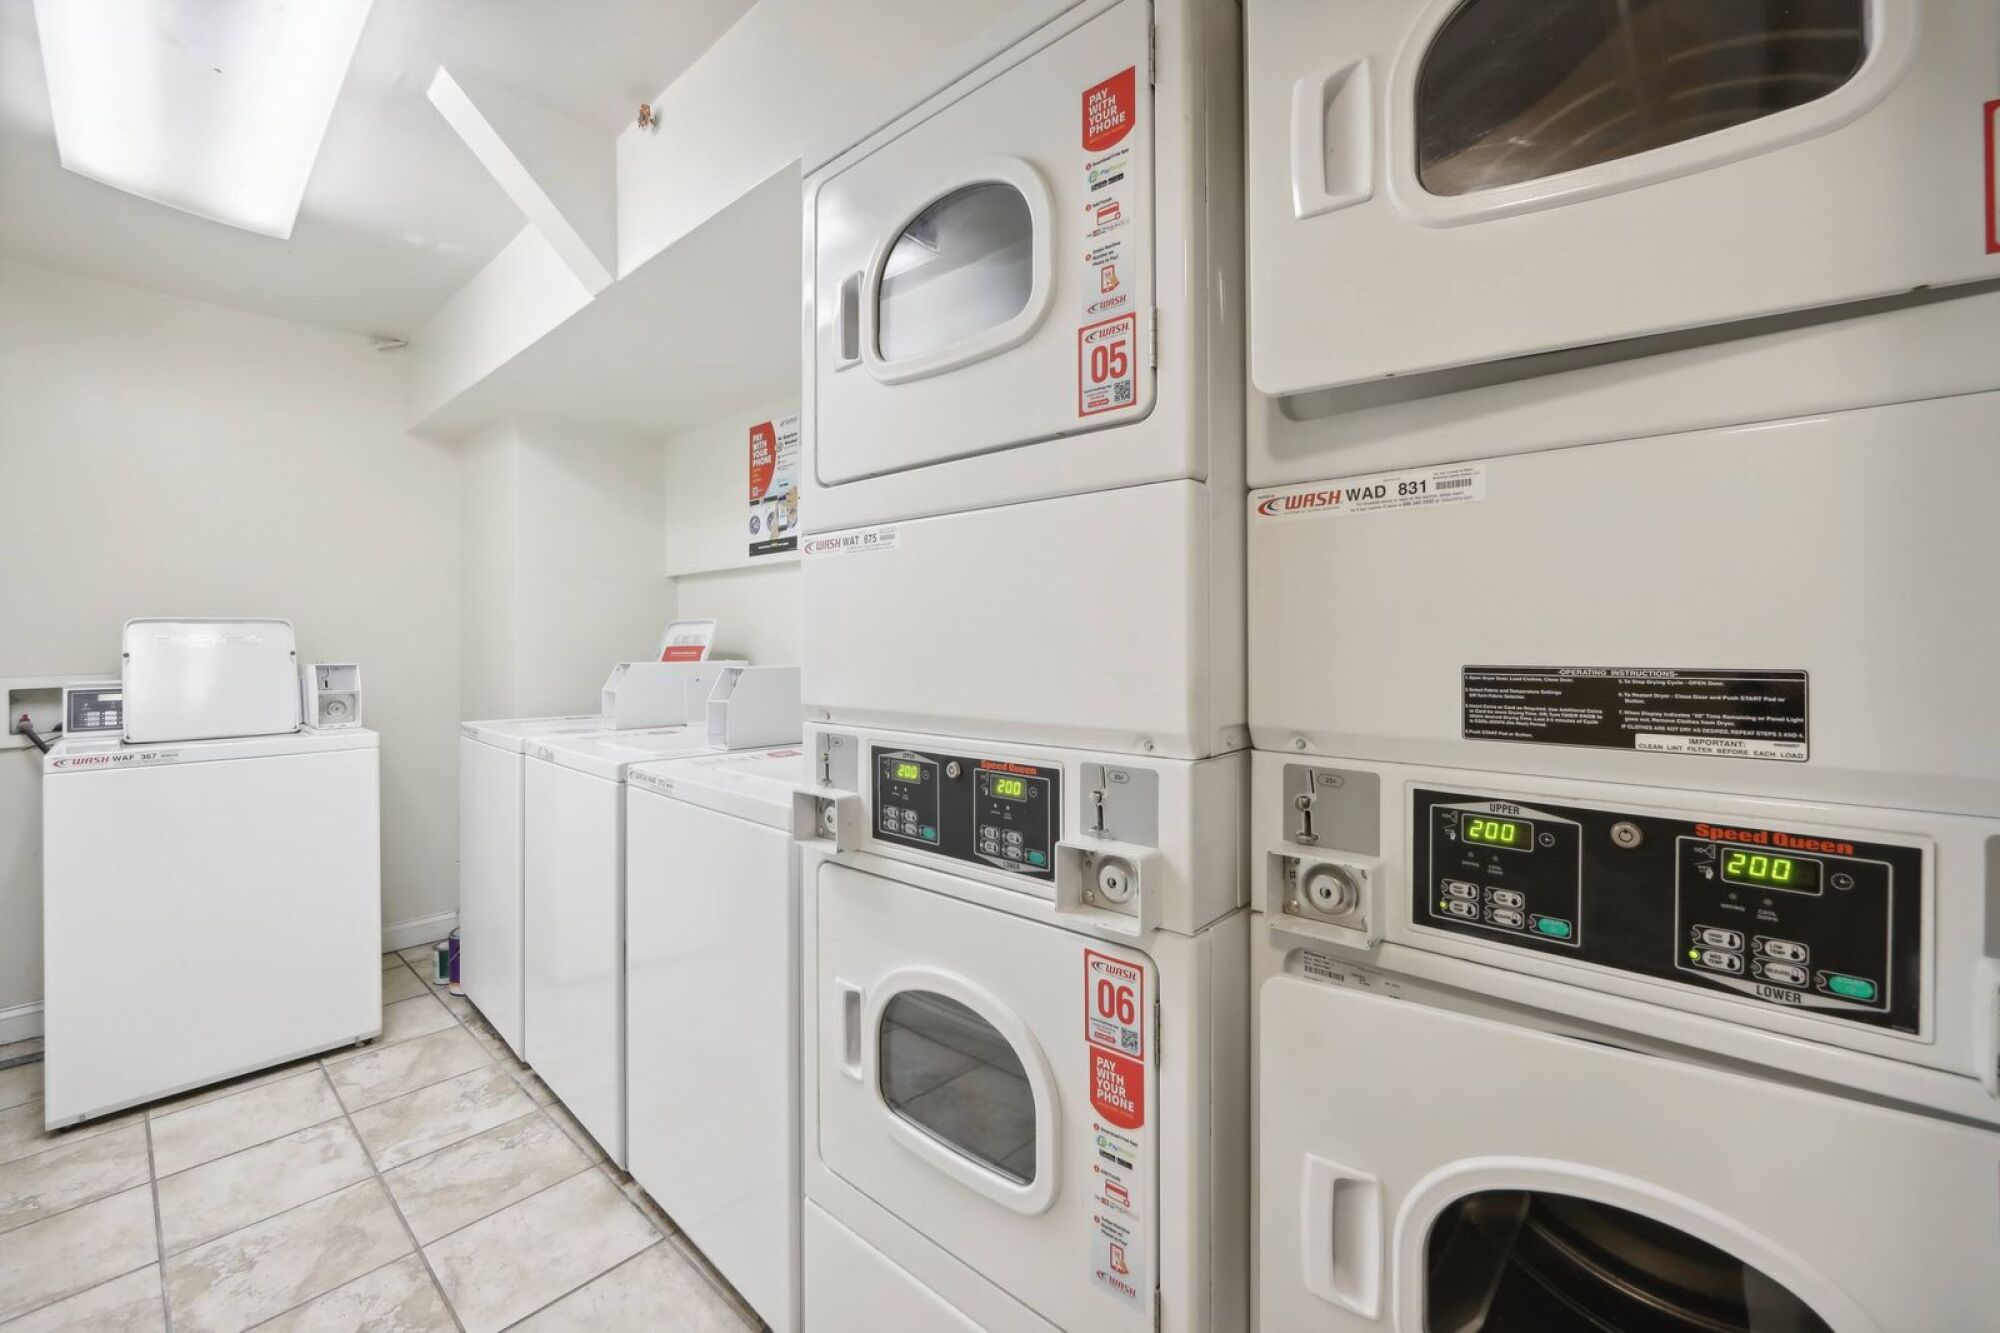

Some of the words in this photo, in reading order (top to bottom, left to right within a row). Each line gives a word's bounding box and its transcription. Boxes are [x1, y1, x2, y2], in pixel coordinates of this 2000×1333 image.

[1089, 88, 1108, 106] PAY
[1089, 94, 1116, 116] WITH
[1089, 105, 1117, 126] YOUR
[1089, 111, 1126, 137] PHONE
[1100, 294, 1126, 308] WASH
[1099, 322, 1129, 339] WASH
[1091, 340, 1128, 384] 05
[1284, 490, 1342, 510] WASH
[1346, 484, 1386, 502] WAD
[1398, 480, 1427, 496] 831
[816, 538, 841, 551] WASH
[842, 536, 860, 546] WAT
[1688, 738, 1746, 748] IMPORTANT:
[1717, 748, 1748, 756] BEFORE
[72, 756, 109, 766] WASH
[112, 754, 134, 762] WAF
[980, 760, 1008, 771] Speed
[1008, 763, 1037, 776] Queen
[897, 764, 918, 780] 200
[996, 778, 1021, 796] 200
[1489, 803, 1520, 814] UPPER
[1469, 819, 1516, 841] 200
[1694, 822, 1768, 845] Speed
[1772, 832, 1854, 856] Queen
[1727, 853, 1791, 880] 200
[1106, 964, 1136, 980] WASH
[1098, 978, 1135, 1026] 06
[1756, 984, 1801, 1004] LOWER
[1096, 1056, 1116, 1072] PAY
[1096, 1066, 1124, 1086] WITH
[1096, 1077, 1126, 1098] YOUR
[1096, 1088, 1135, 1113] PHONE
[1108, 1275, 1136, 1298] WASH
